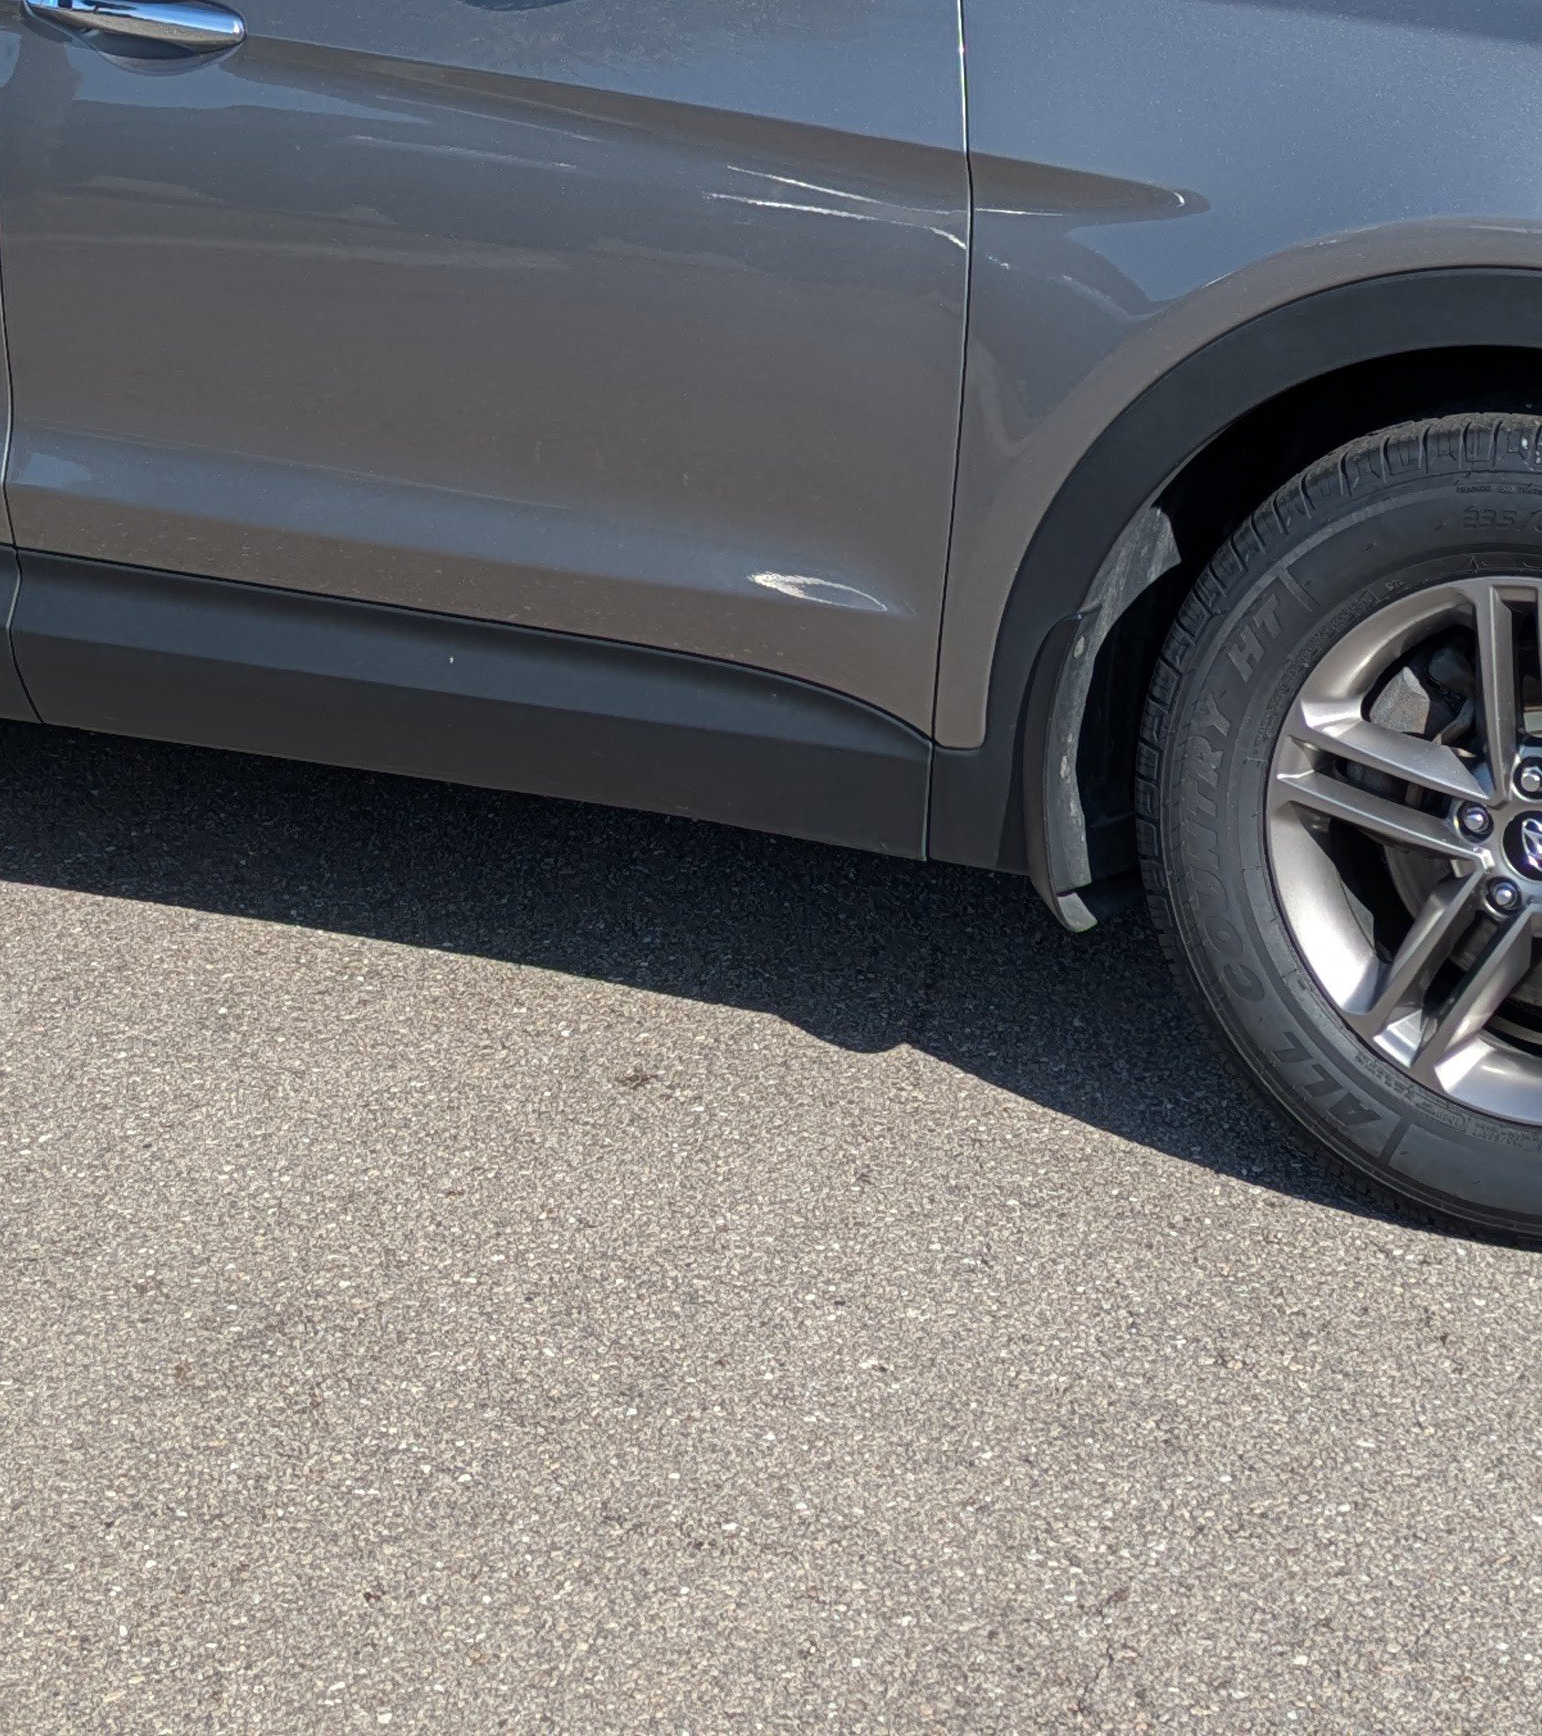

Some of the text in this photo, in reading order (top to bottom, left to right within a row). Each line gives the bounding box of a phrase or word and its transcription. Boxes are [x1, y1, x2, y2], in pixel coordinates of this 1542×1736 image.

[1188, 594, 1384, 1130] ALL COUNTRY HT
